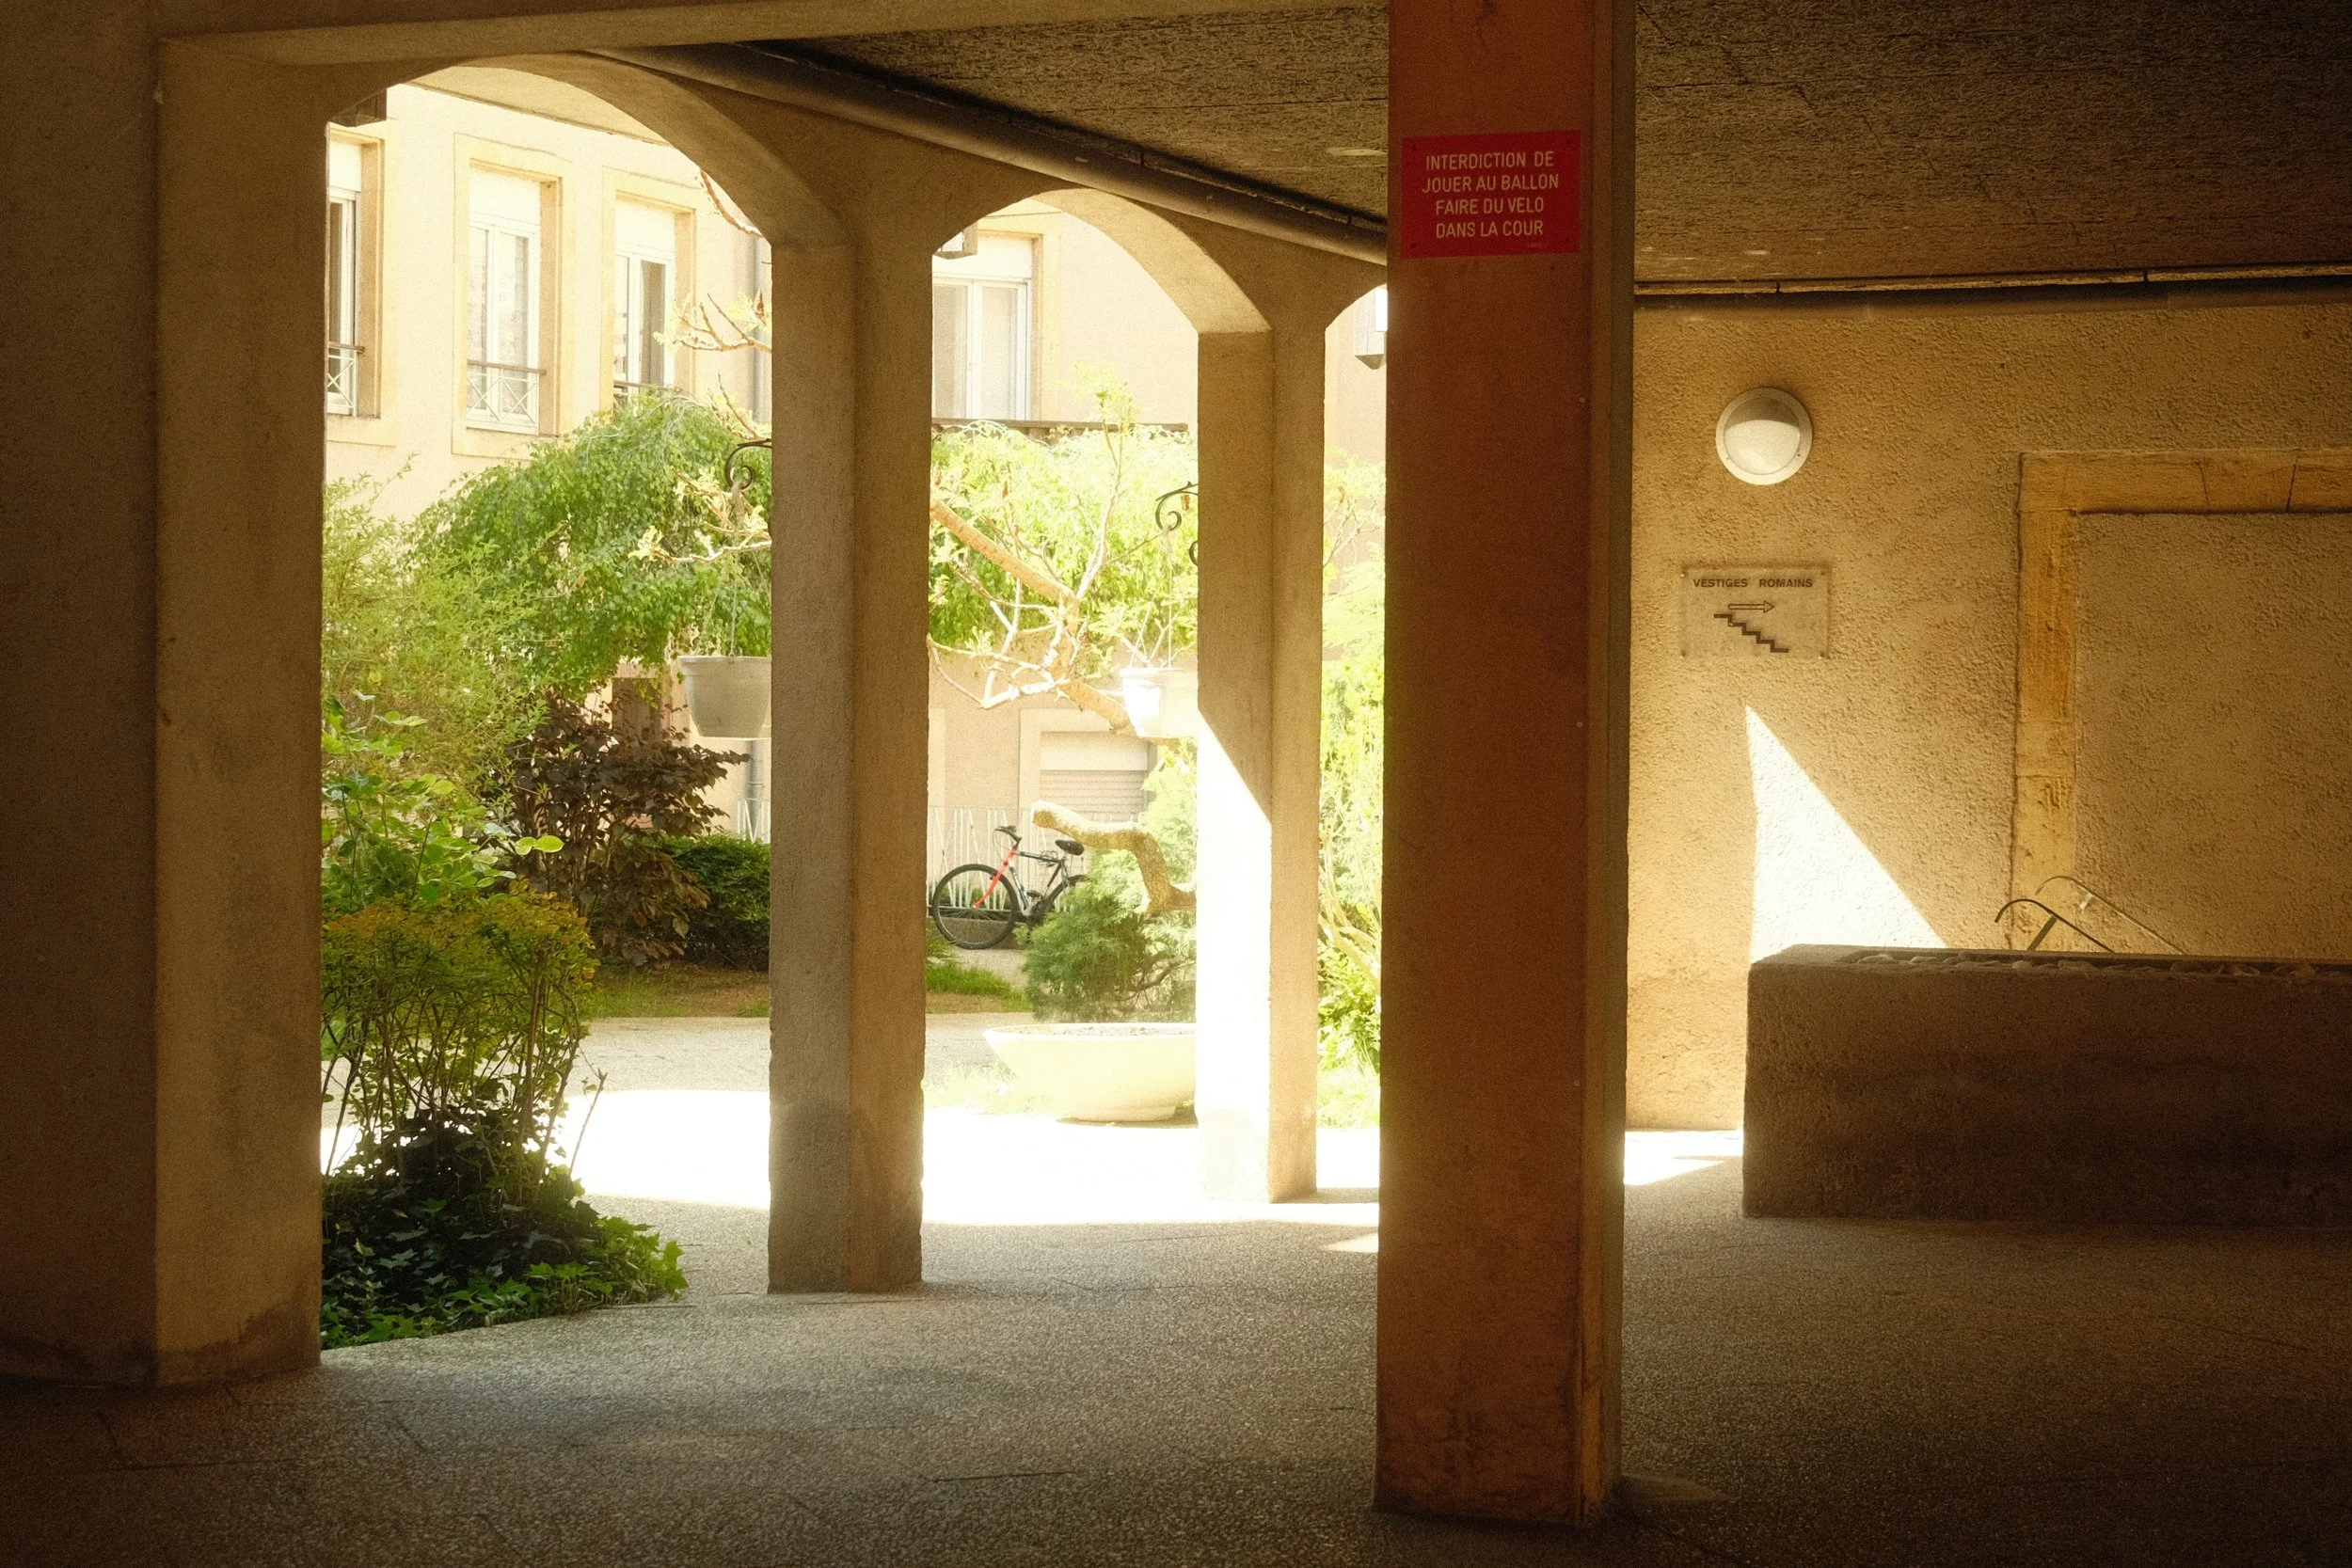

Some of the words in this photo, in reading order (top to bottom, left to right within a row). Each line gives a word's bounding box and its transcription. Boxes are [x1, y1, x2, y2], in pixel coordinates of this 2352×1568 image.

[1426, 152, 1526, 170] INTERDICTION
[1534, 150, 1554, 166] DE
[1422, 176, 1471, 194] JOUER
[1475, 175, 1496, 191] AU
[1502, 173, 1559, 190] BALLON
[1436, 198, 1478, 215] FAIRE
[1484, 198, 1503, 214] DU
[1507, 197, 1544, 213] VELO
[1436, 222, 1475, 238] DANS
[1480, 221, 1498, 237] LA
[1502, 220, 1543, 236] COUR
[1693, 578, 1748, 587] VESTIGES
[1759, 578, 1813, 587] ROMAINS
